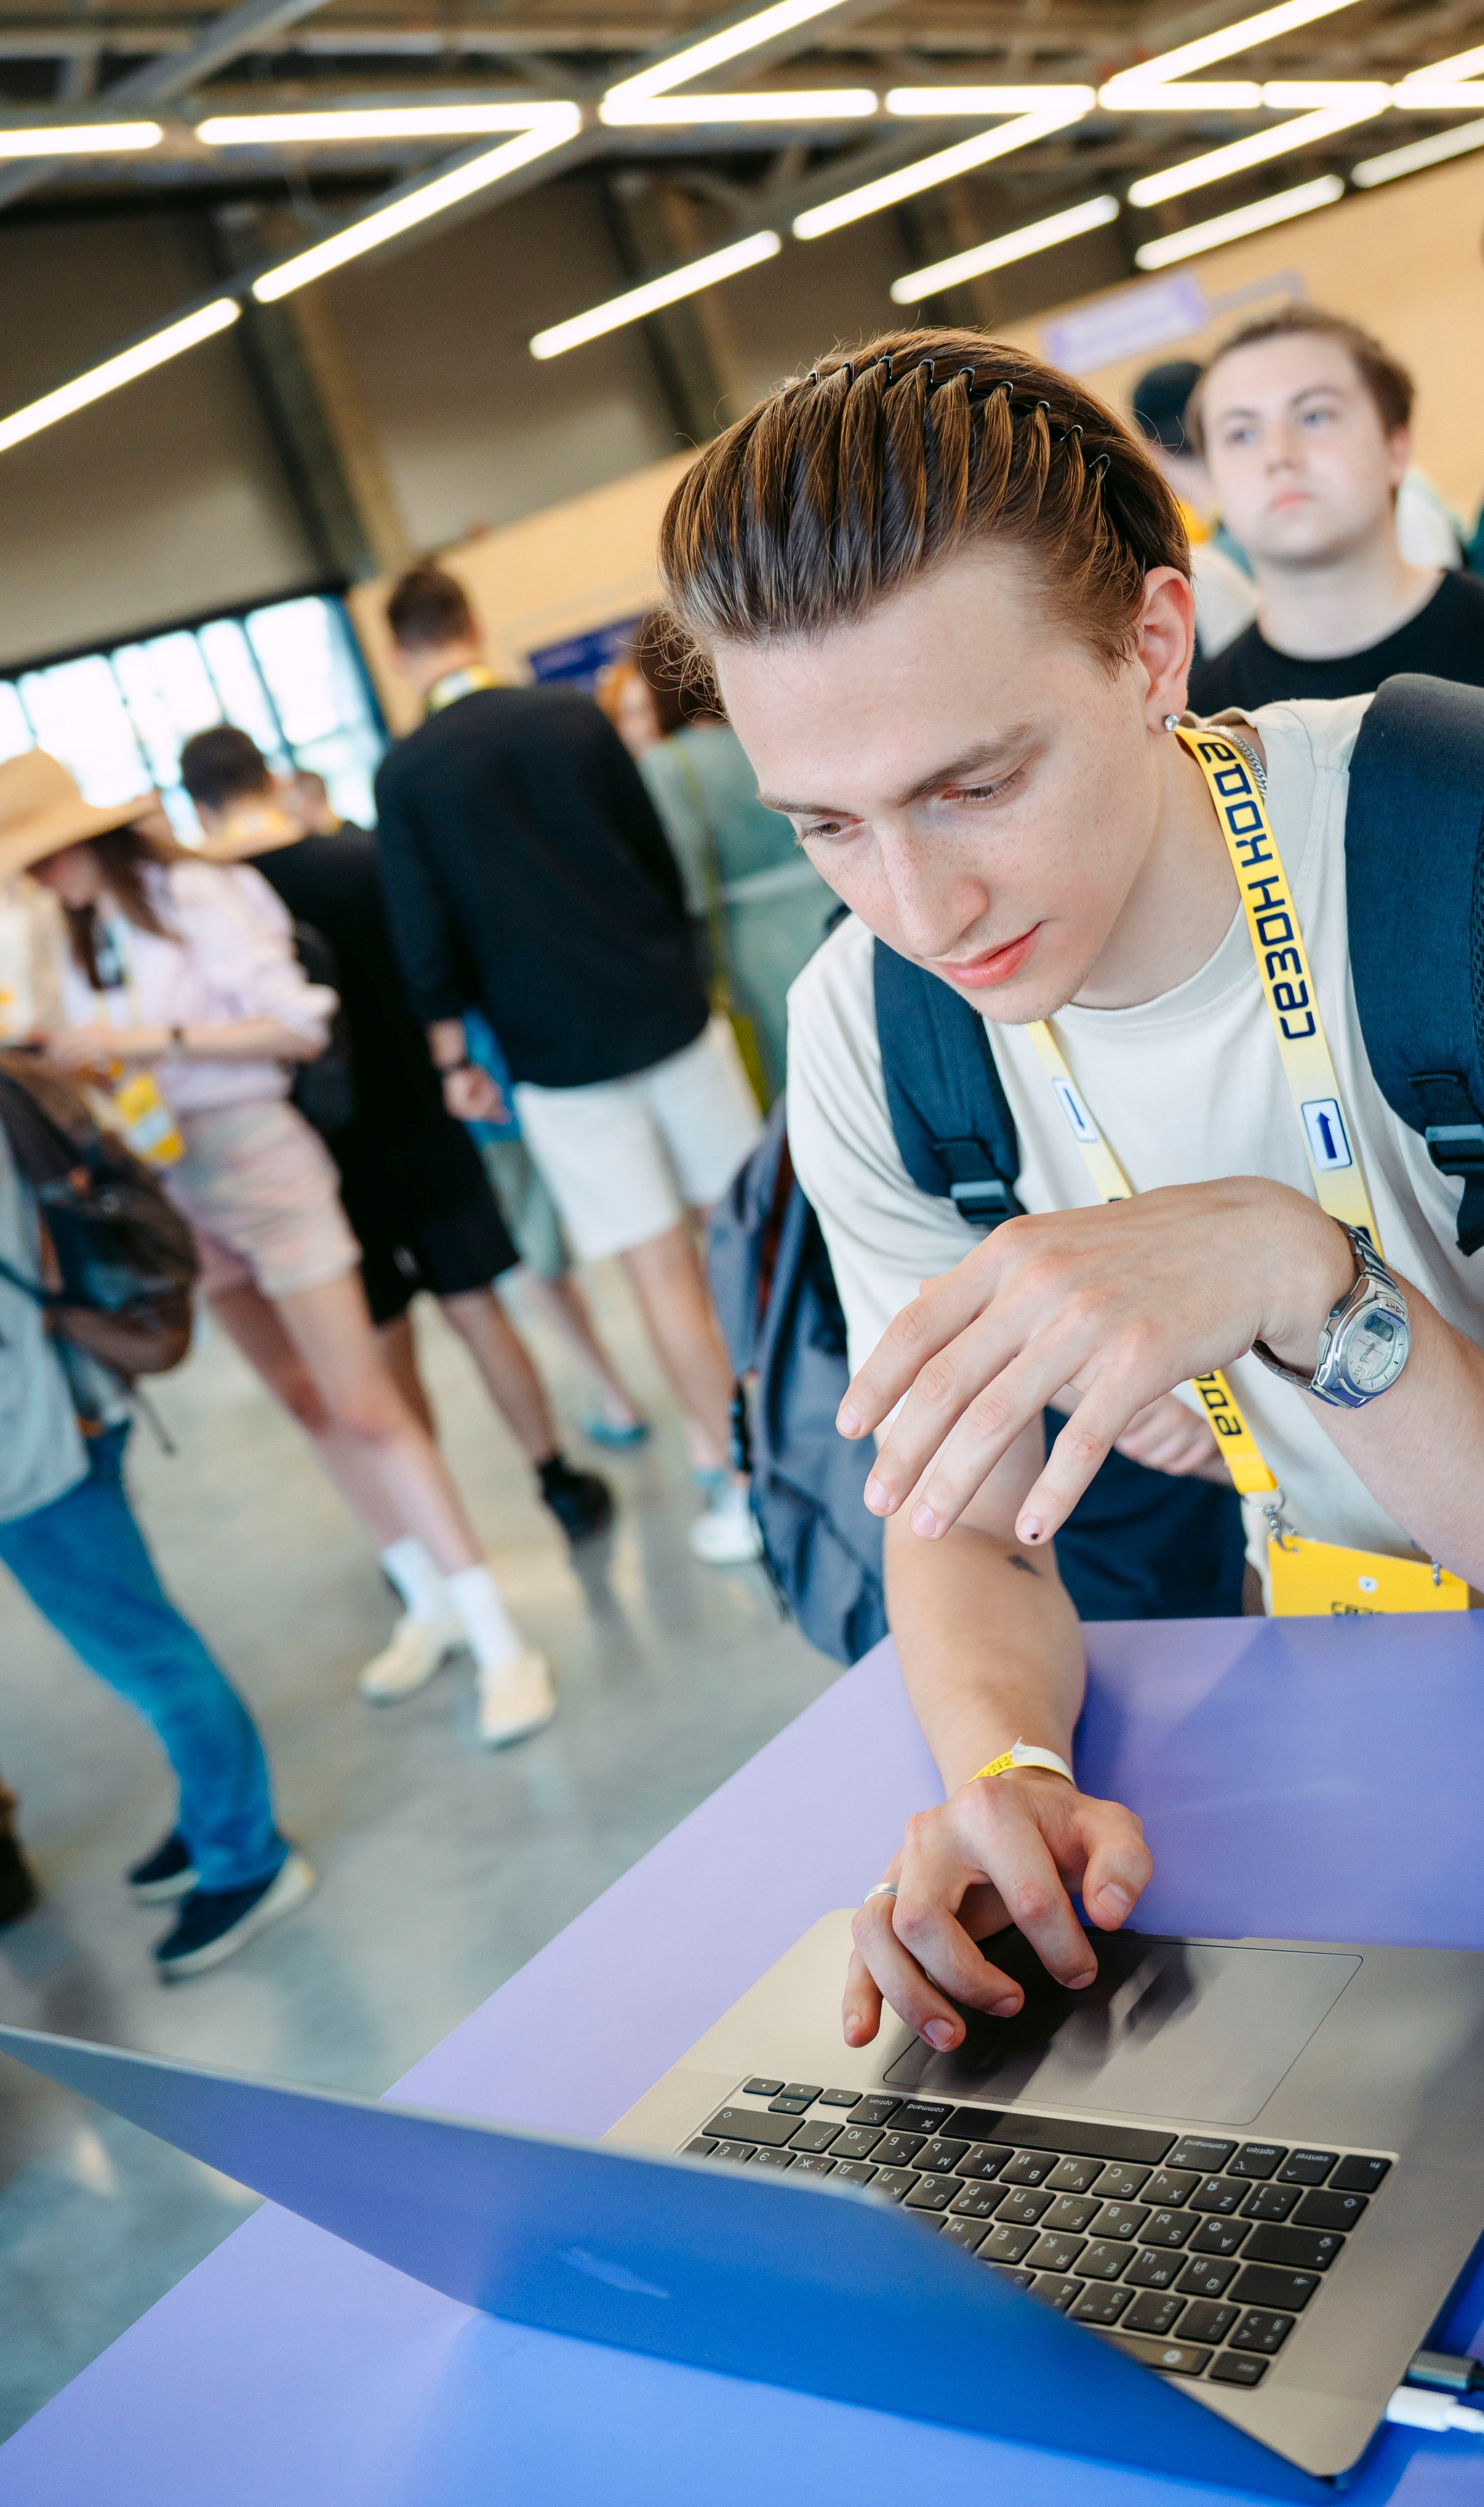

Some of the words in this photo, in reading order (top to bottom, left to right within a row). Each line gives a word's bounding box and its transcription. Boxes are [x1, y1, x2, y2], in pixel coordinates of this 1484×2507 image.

[1385, 1301, 1405, 1318] LIGHT
[907, 2104, 944, 2113] command
[848, 2131, 862, 2139] Ю
[889, 2137, 900, 2145] Б
[1184, 2139, 1228, 2149] command
[974, 2150, 983, 2158] Т
[1247, 2146, 1275, 2155] option
[937, 2156, 952, 2165] M
[1018, 2155, 1031, 2164] И
[1296, 2153, 1329, 2162] control
[798, 2159, 814, 2168] Ж
[982, 2163, 996, 2172] N
[1064, 2162, 1077, 2171] М
[839, 2164, 853, 2174] Д
[881, 2172, 894, 2181] Л
[1029, 2170, 1041, 2179] B
[1157, 2174, 1168, 2184] Ч
[924, 2180, 936, 2188] О
[1072, 2176, 1084, 2186] V
[1207, 2180, 1220, 2191] Я
[969, 2186, 980, 2195] Р
[1121, 2183, 1133, 2192] C
[1013, 2193, 1027, 2203] П
[1169, 2189, 1182, 2199] X
[977, 2201, 990, 2210] H
[1062, 2200, 1072, 2209] А
[1220, 2196, 1233, 2206] Z
[1024, 2208, 1035, 2217] G
[1109, 2207, 1120, 2217] В
[1072, 2216, 1084, 2225] F
[1156, 2213, 1172, 2224] Ы
[1119, 2223, 1133, 2233] D
[1209, 2221, 1223, 2232] Ф
[997, 2230, 1009, 2240] Е
[1169, 2230, 1182, 2240] S
[1221, 2238, 1233, 2248] A
[1007, 2247, 1018, 2257] T
[1093, 2246, 1106, 2255] У
[1056, 2254, 1068, 2264] R
[1142, 2251, 1157, 2263] Ц
[1105, 2262, 1117, 2273] E
[1193, 2261, 1209, 2274] Й
[1151, 2270, 1168, 2281] W
[1206, 2277, 1220, 2289] Q
[1061, 2284, 1073, 2295] 4
[1111, 2293, 1124, 2304] 3
[1163, 2301, 1176, 2312] 2
